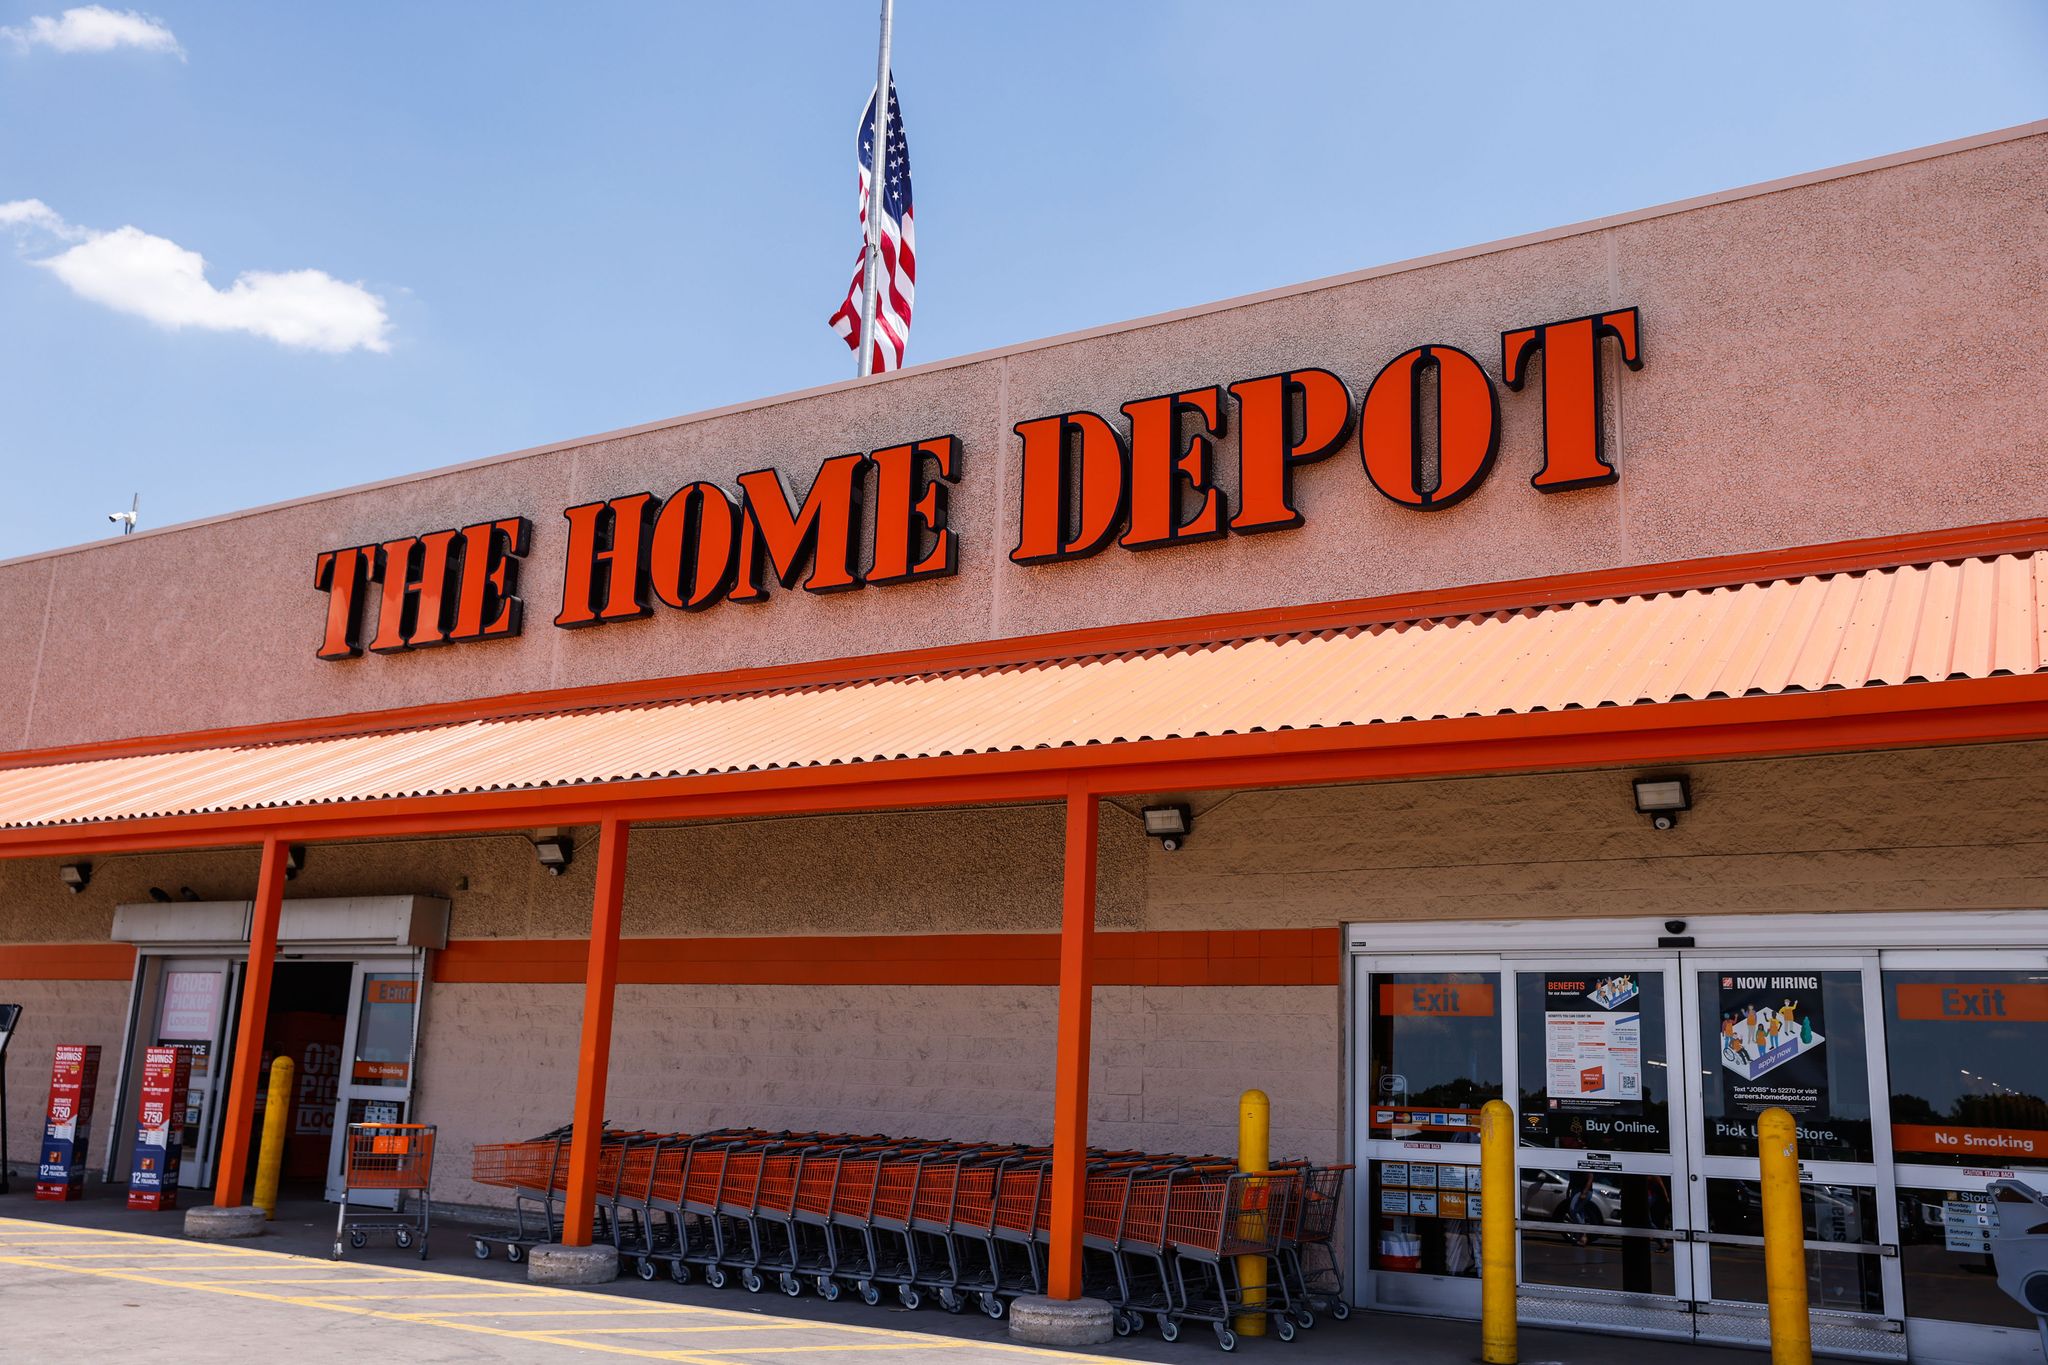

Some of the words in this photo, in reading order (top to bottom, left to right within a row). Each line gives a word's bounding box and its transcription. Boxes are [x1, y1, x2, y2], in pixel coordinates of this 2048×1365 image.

[314, 515, 532, 661] THE
[554, 434, 963, 630] HOME
[1009, 306, 1644, 567] DEPOT
[173, 975, 214, 992] ORDER
[1548, 982, 1585, 990] BENEFITS
[1737, 977, 1767, 989] NOW
[1772, 977, 1818, 989] HIRING
[171, 993, 212, 1010] PICKUP
[1413, 987, 1459, 1012] Exit
[1941, 988, 2007, 1016] Exit
[56, 1052, 82, 1061] SAVINGS
[146, 1054, 173, 1063] SAVINGS
[1758, 1055, 1776, 1069] apply
[1776, 1046, 1792, 1059] now
[378, 1067, 404, 1077] Smoking
[52, 1106, 70, 1118] $750
[143, 1111, 162, 1123] $750
[1586, 1119, 1610, 1134] Buy
[1614, 1120, 1660, 1134] Online.
[1716, 1124, 1747, 1137] Pick
[1796, 1128, 1838, 1140] Store.
[1935, 1133, 1958, 1145] No
[1964, 1134, 2034, 1151] Smoking
[40, 1164, 49, 1176] 12
[2001, 1170, 2014, 1178] BACK
[132, 1172, 140, 1184] 12
[1961, 1192, 1992, 1203] Store
[1983, 1230, 1990, 1238] 6
[1984, 1243, 1991, 1251] 8
